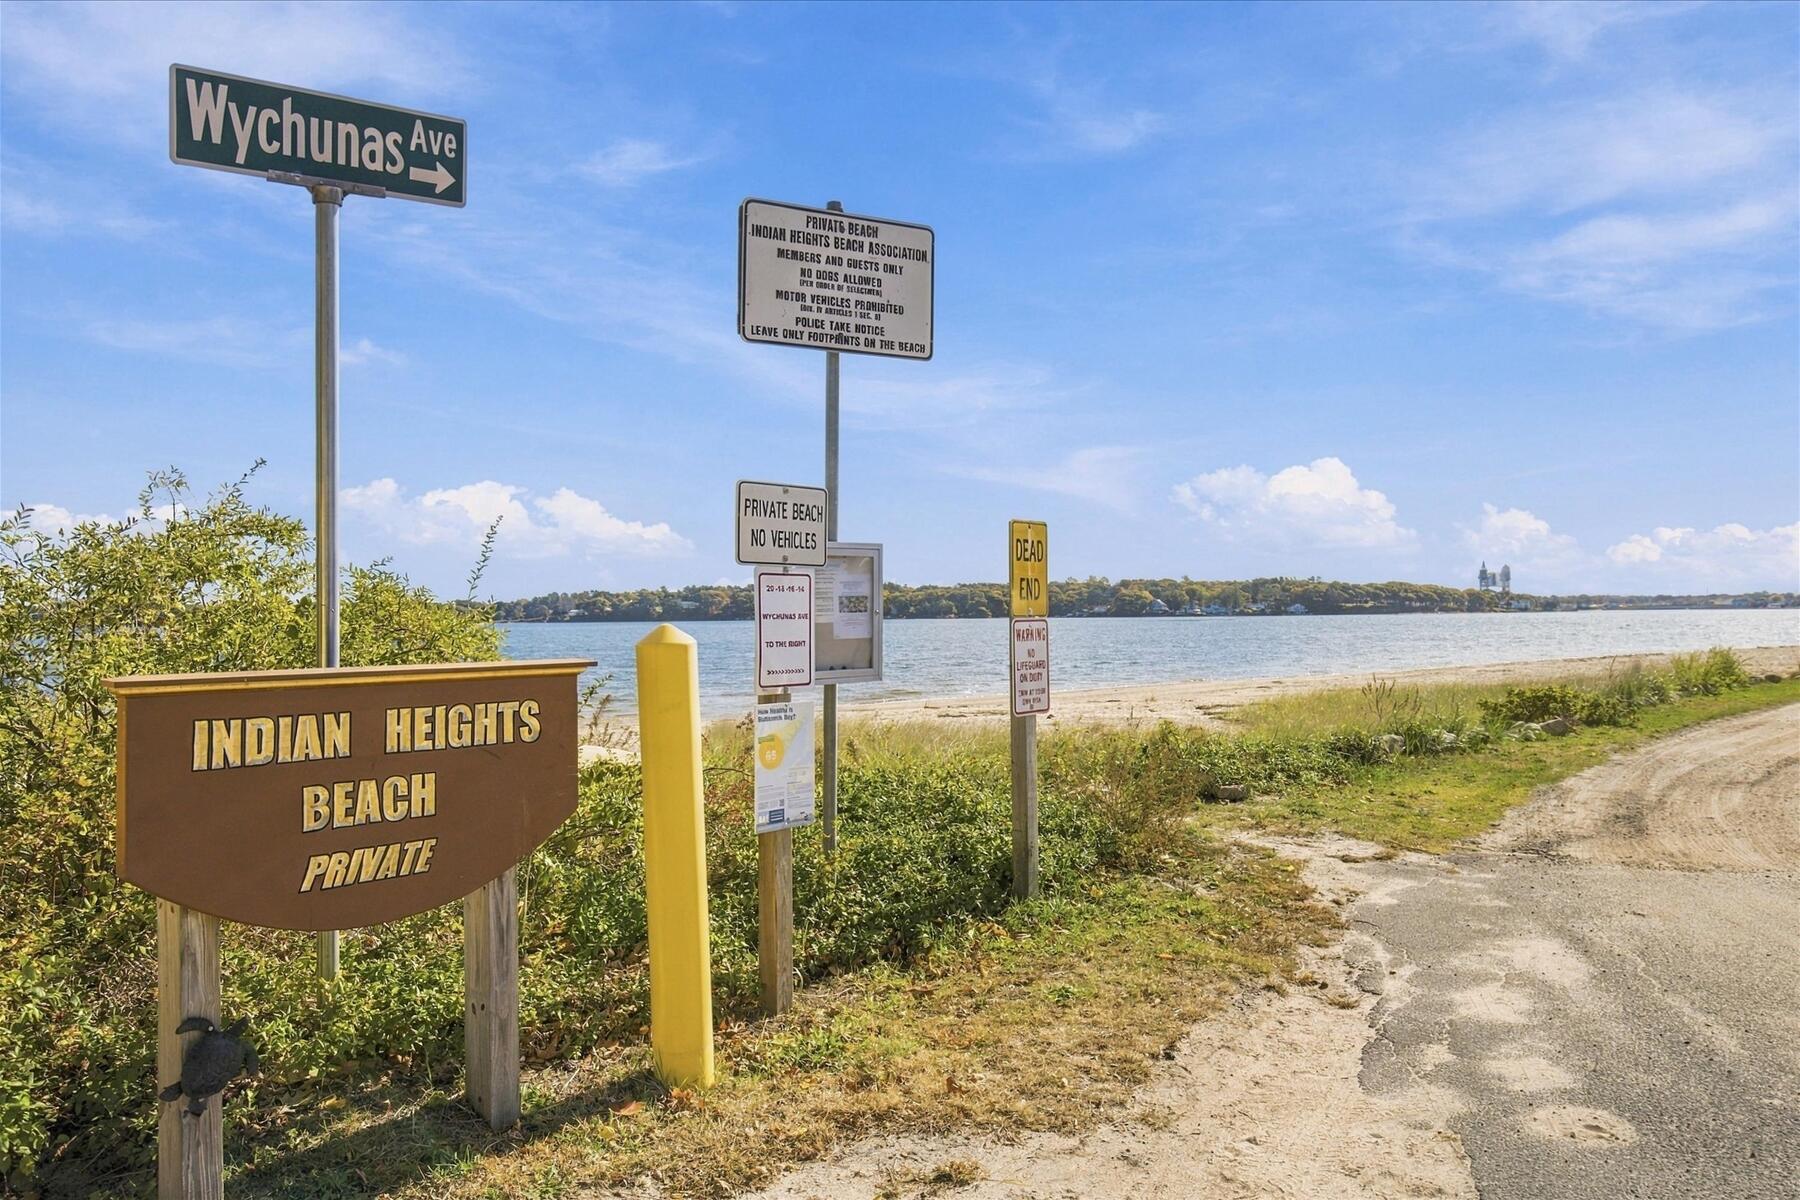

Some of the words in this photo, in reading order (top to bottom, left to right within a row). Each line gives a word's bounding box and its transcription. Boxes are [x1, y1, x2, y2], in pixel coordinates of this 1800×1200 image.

[185, 77, 405, 175] Wychunas
[409, 119, 457, 158] Ave
[806, 215, 845, 234] PRIVATE
[848, 221, 879, 239] BEACH
[751, 223, 787, 242] INDIAN
[789, 229, 831, 249] HEIGHTS
[834, 236, 864, 253] BEACH
[868, 241, 928, 263] ASSOCIATION
[776, 247, 822, 264] MEMBERS
[825, 255, 844, 266] AND
[847, 257, 880, 272] GUESTS
[883, 264, 904, 275] ONLY
[800, 267, 812, 278] NO
[816, 269, 839, 282] DOGS
[843, 273, 882, 288] ALLOWED
[816, 281, 835, 290] ORDER
[837, 284, 845, 292] OF
[775, 289, 806, 303] MOTOR
[810, 293, 851, 308] VEHICLES
[855, 299, 904, 315] PROHIBITED
[825, 307, 852, 317] ARTICLES
[795, 316, 825, 330] POLICE
[829, 320, 851, 333] TAKE
[854, 324, 885, 336] NOTICE
[751, 325, 778, 338] LEAVE
[782, 328, 804, 341] ONLY
[808, 331, 860, 347] FOOTPRINTS
[864, 337, 876, 349] ON
[880, 339, 895, 351] THE
[898, 341, 926, 354] BEACH
[744, 498, 788, 519] PRIVATE
[792, 503, 823, 523] BEACH
[750, 528, 766, 547] NO
[771, 530, 817, 550] VEHICLES
[1015, 538, 1044, 563] DEAD
[1019, 577, 1041, 600] END
[775, 640, 787, 648] THE
[788, 640, 806, 648] RIGHT
[1015, 627, 1046, 642] WARNING
[1027, 648, 1036, 658] NO
[1016, 660, 1046, 672] LIFEGUARD
[1020, 673, 1028, 683] ON
[1029, 672, 1043, 682] DUTY
[192, 711, 351, 772] INDIAN
[384, 699, 541, 754] HEIGHTS
[301, 772, 436, 833] BEACH
[299, 837, 438, 893] PRIVATE
